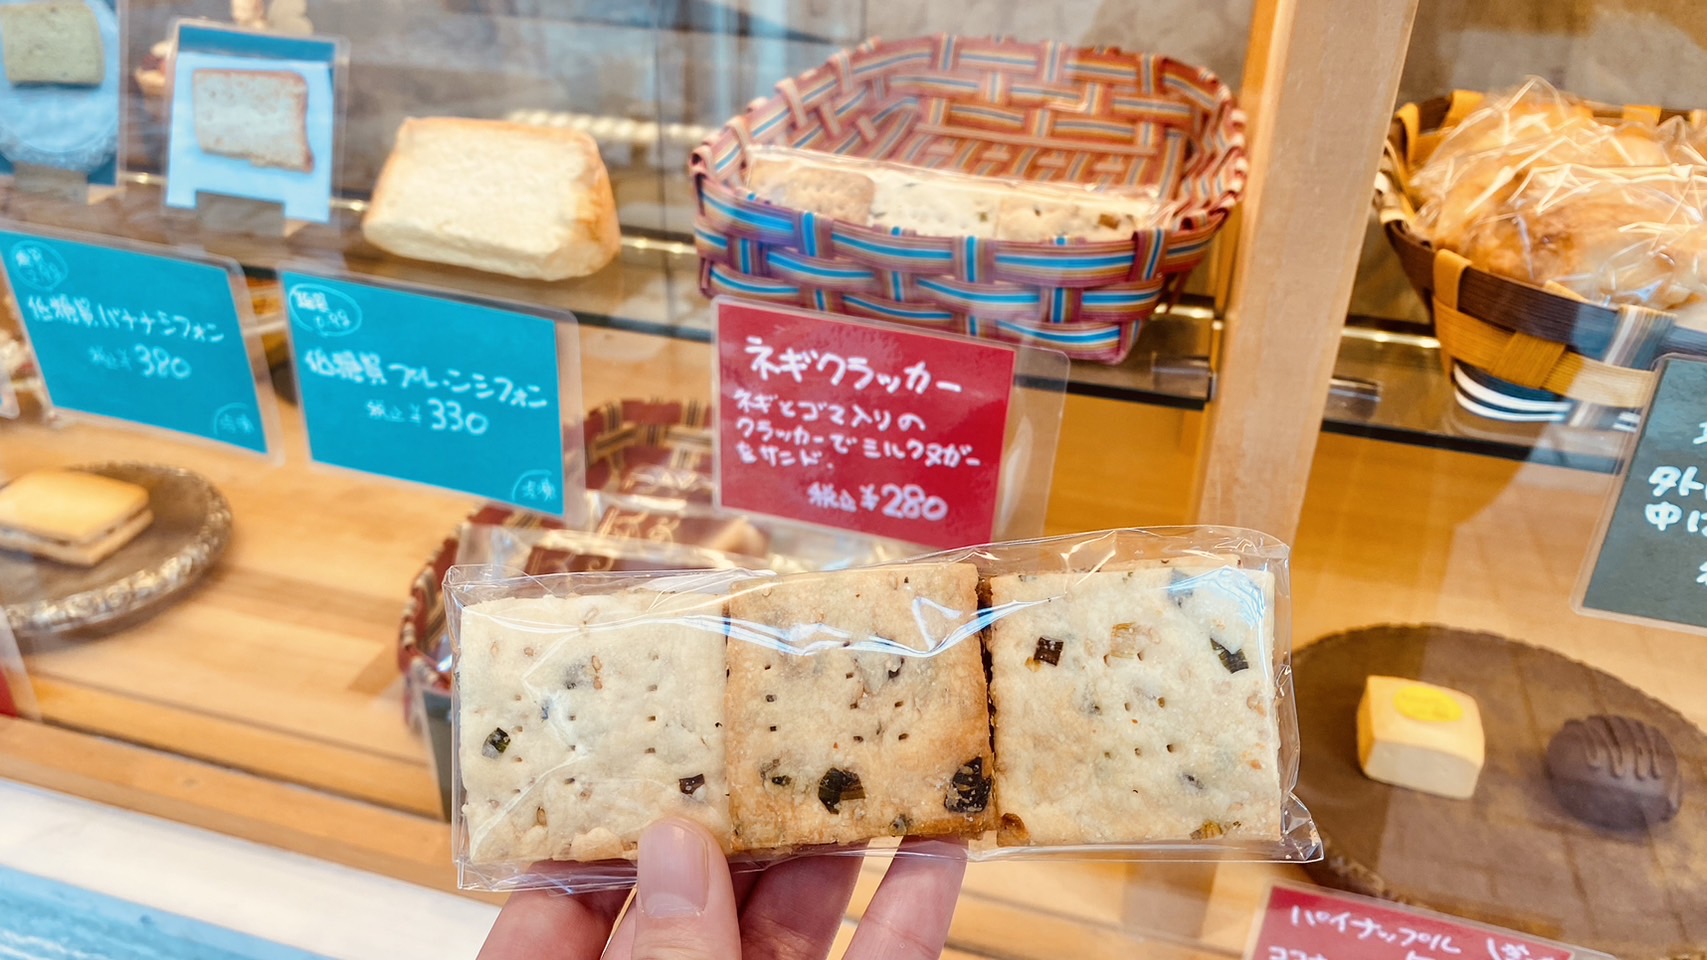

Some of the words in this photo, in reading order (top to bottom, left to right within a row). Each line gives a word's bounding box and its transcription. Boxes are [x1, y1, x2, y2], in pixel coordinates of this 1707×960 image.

[745, 336, 962, 394] ネギクラッカー
[733, 390, 926, 431] ネギとゴマ入りの
[735, 418, 981, 468] クラッカーでミルクヌガー
